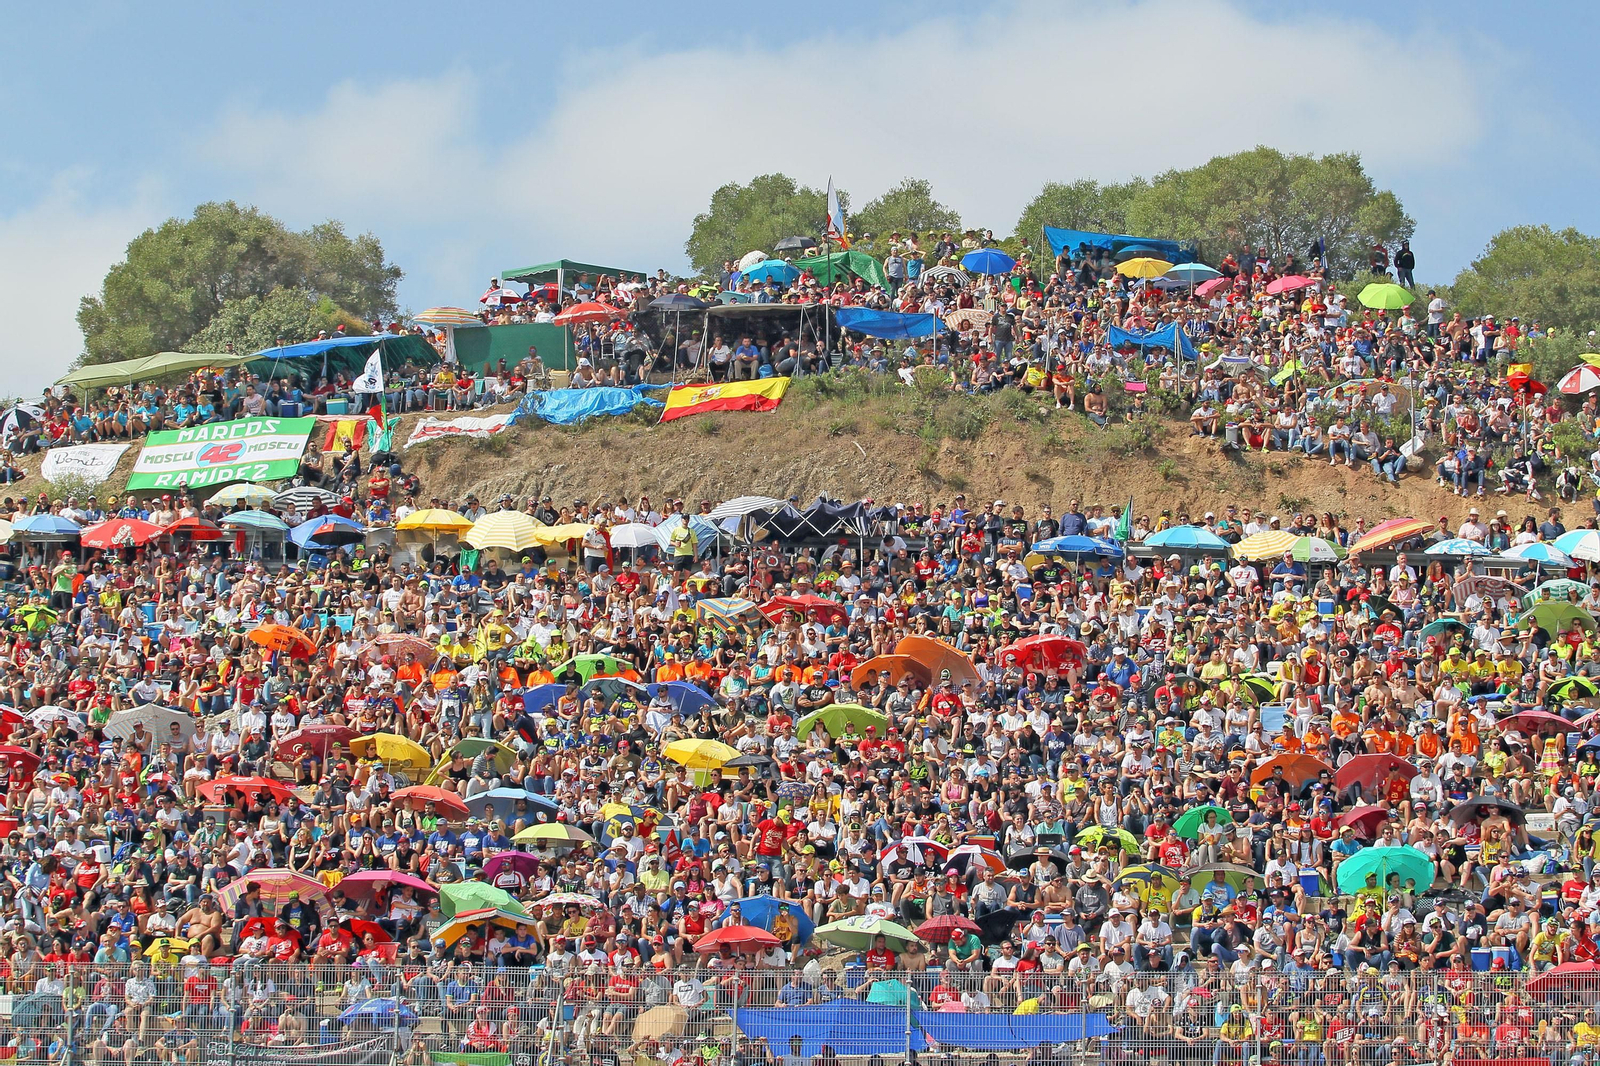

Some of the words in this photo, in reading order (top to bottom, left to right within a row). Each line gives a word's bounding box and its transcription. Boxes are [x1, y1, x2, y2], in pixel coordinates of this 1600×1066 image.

[176, 420, 281, 443] MARCOS
[199, 443, 243, 464] 42
[247, 440, 299, 453] MOSCU
[143, 451, 194, 464] MOSCU
